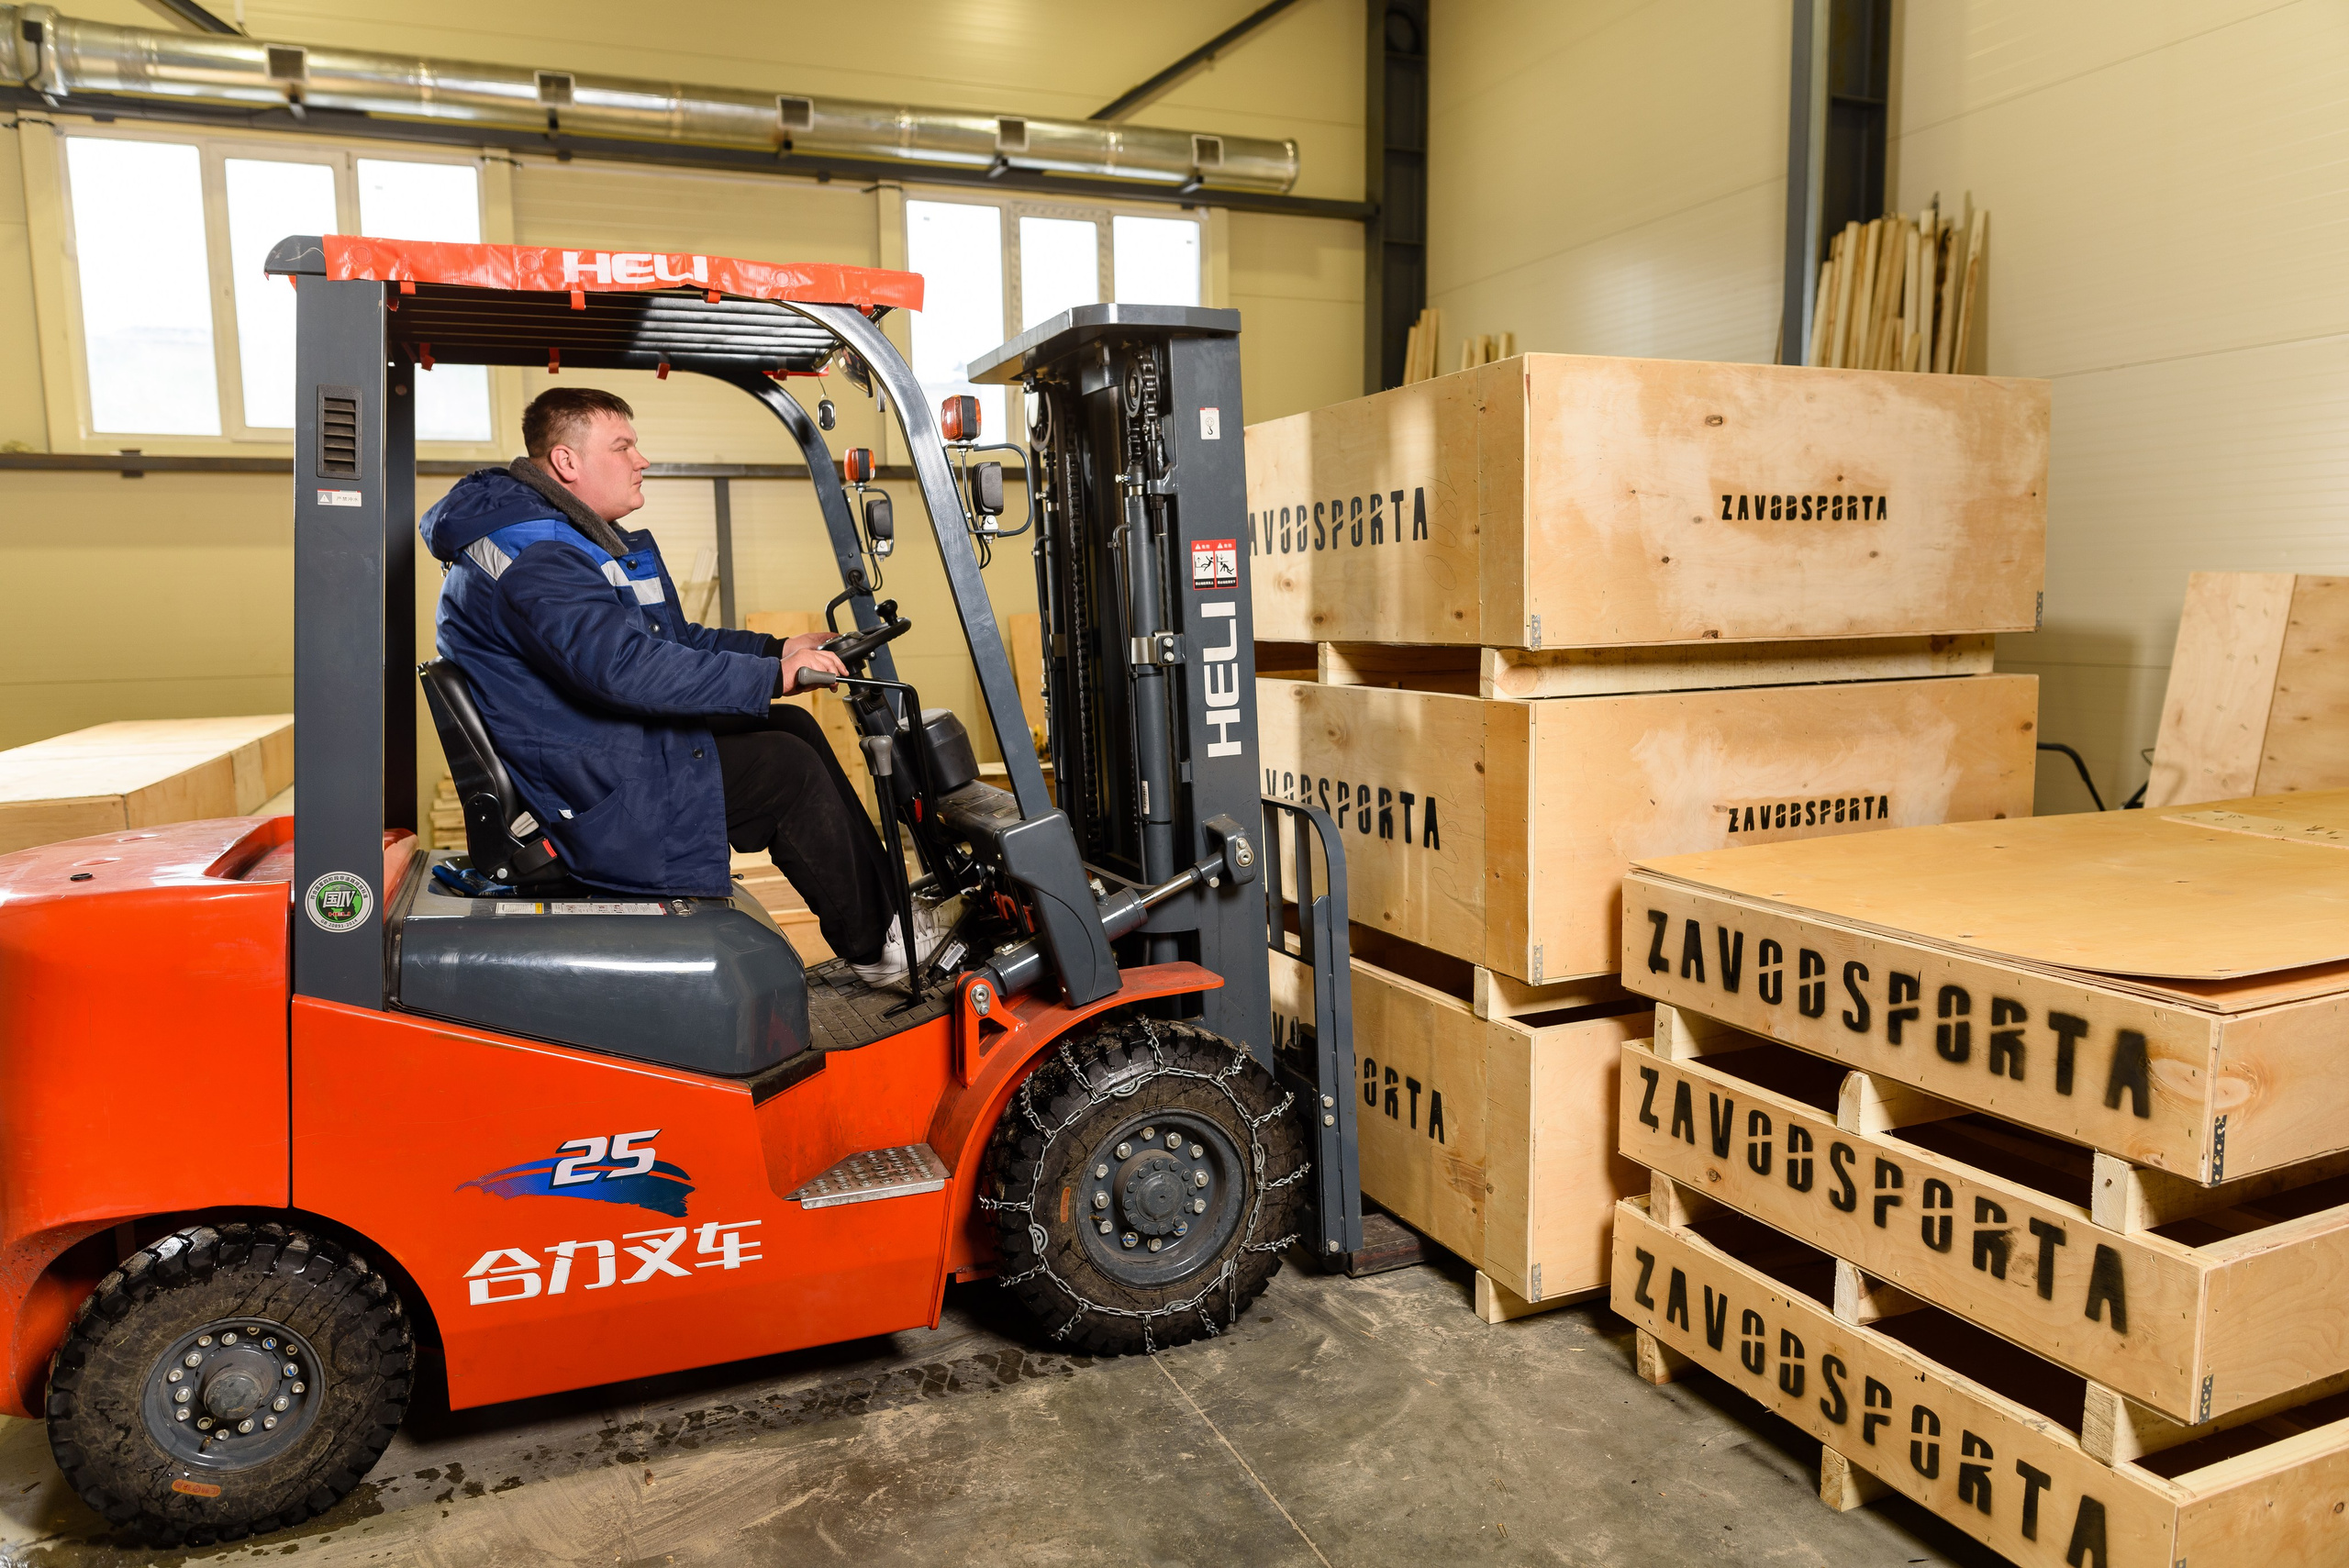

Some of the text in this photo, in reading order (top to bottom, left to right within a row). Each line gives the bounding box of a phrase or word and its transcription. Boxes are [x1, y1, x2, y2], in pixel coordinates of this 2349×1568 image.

[562, 250, 708, 284] HELI
[1249, 486, 1429, 556] AVODSPORTA
[1721, 495, 1887, 521] ZAVODSPORTA
[1201, 601, 1241, 758] HELI
[1265, 769, 1441, 851] VODSPORTA
[1728, 795, 1889, 833] ZAVODSPORTA
[1646, 908, 2152, 1120] ZAVODSPORTA
[549, 1129, 663, 1190] 25
[1638, 1063, 2128, 1337] ZAVODSPORTA
[462, 1219, 763, 1306] 合力叉车
[1635, 1246, 2109, 1568] ZAVODSPORTA
